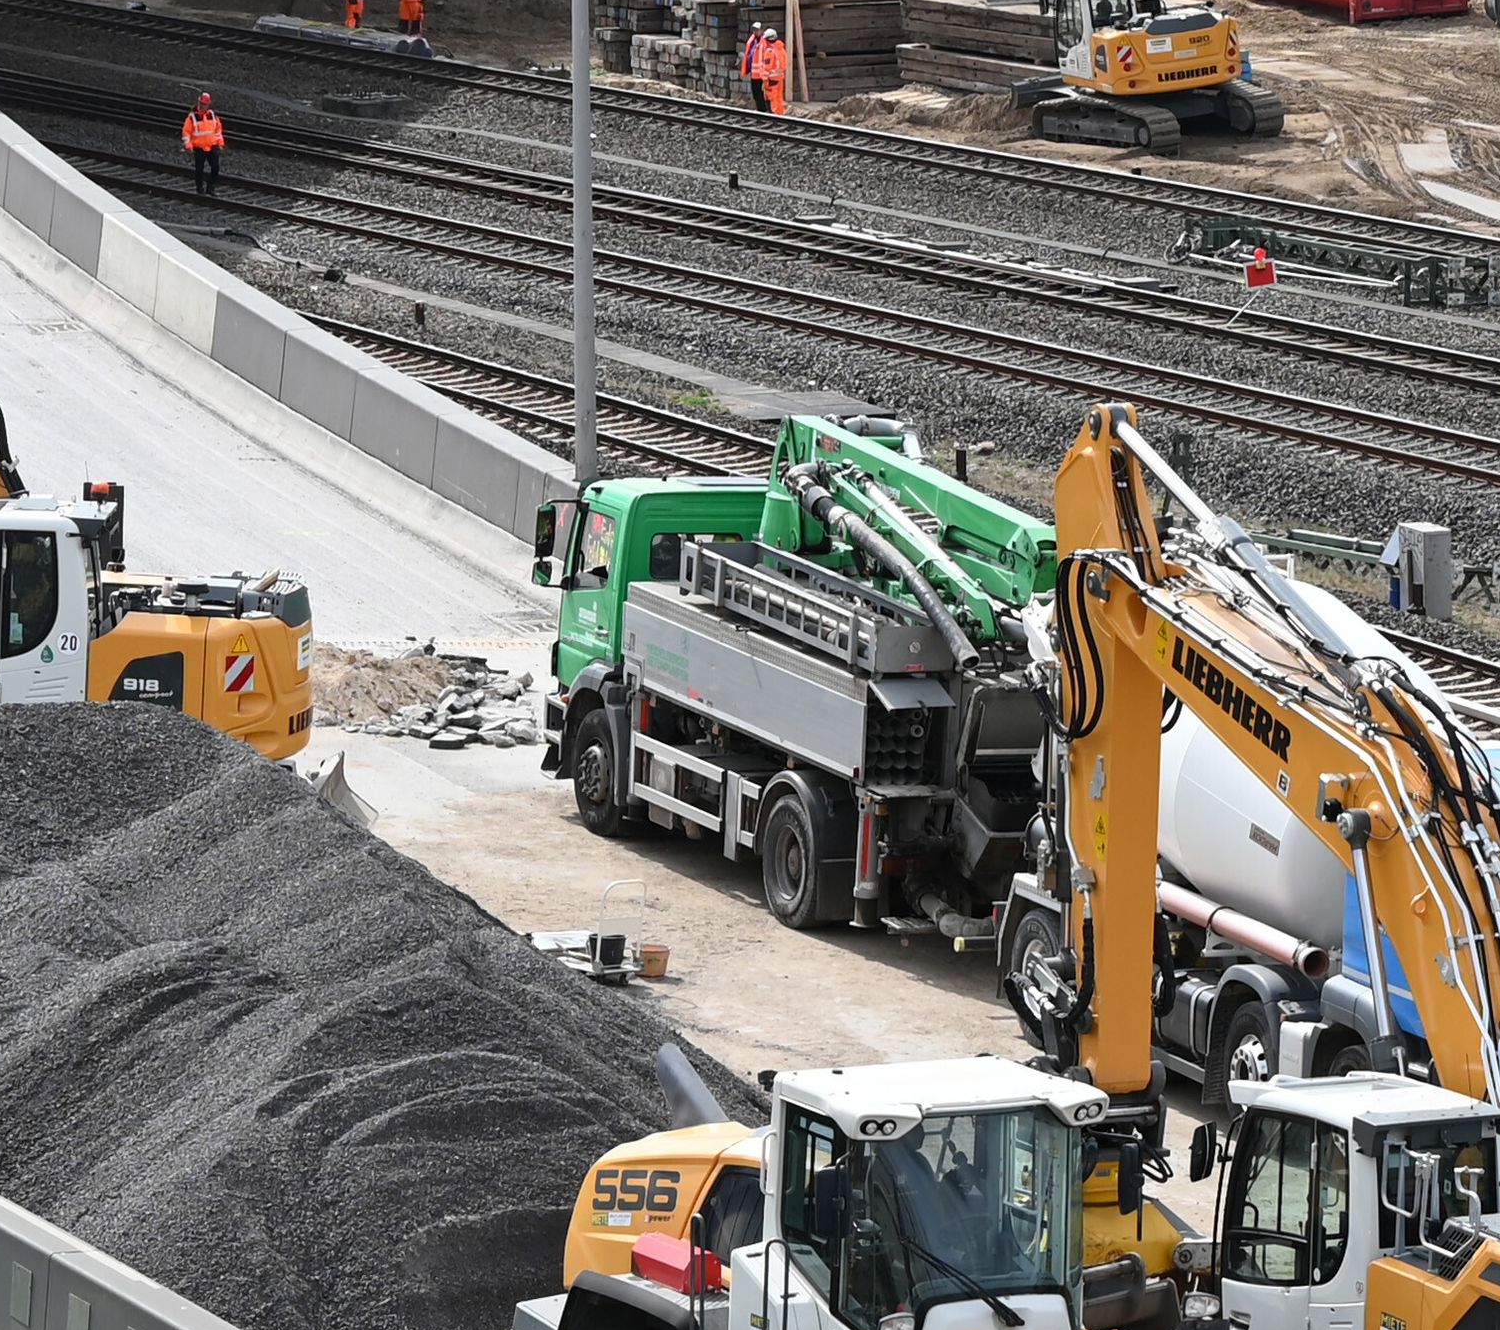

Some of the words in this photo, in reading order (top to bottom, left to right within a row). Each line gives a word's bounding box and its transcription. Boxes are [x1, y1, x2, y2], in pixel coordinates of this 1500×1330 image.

[1157, 65, 1219, 83] LIEBHERR
[60, 635, 77, 652] 20
[123, 678, 159, 692] 918
[1171, 639, 1291, 764] LIEBHERR
[592, 1170, 681, 1212] 556
